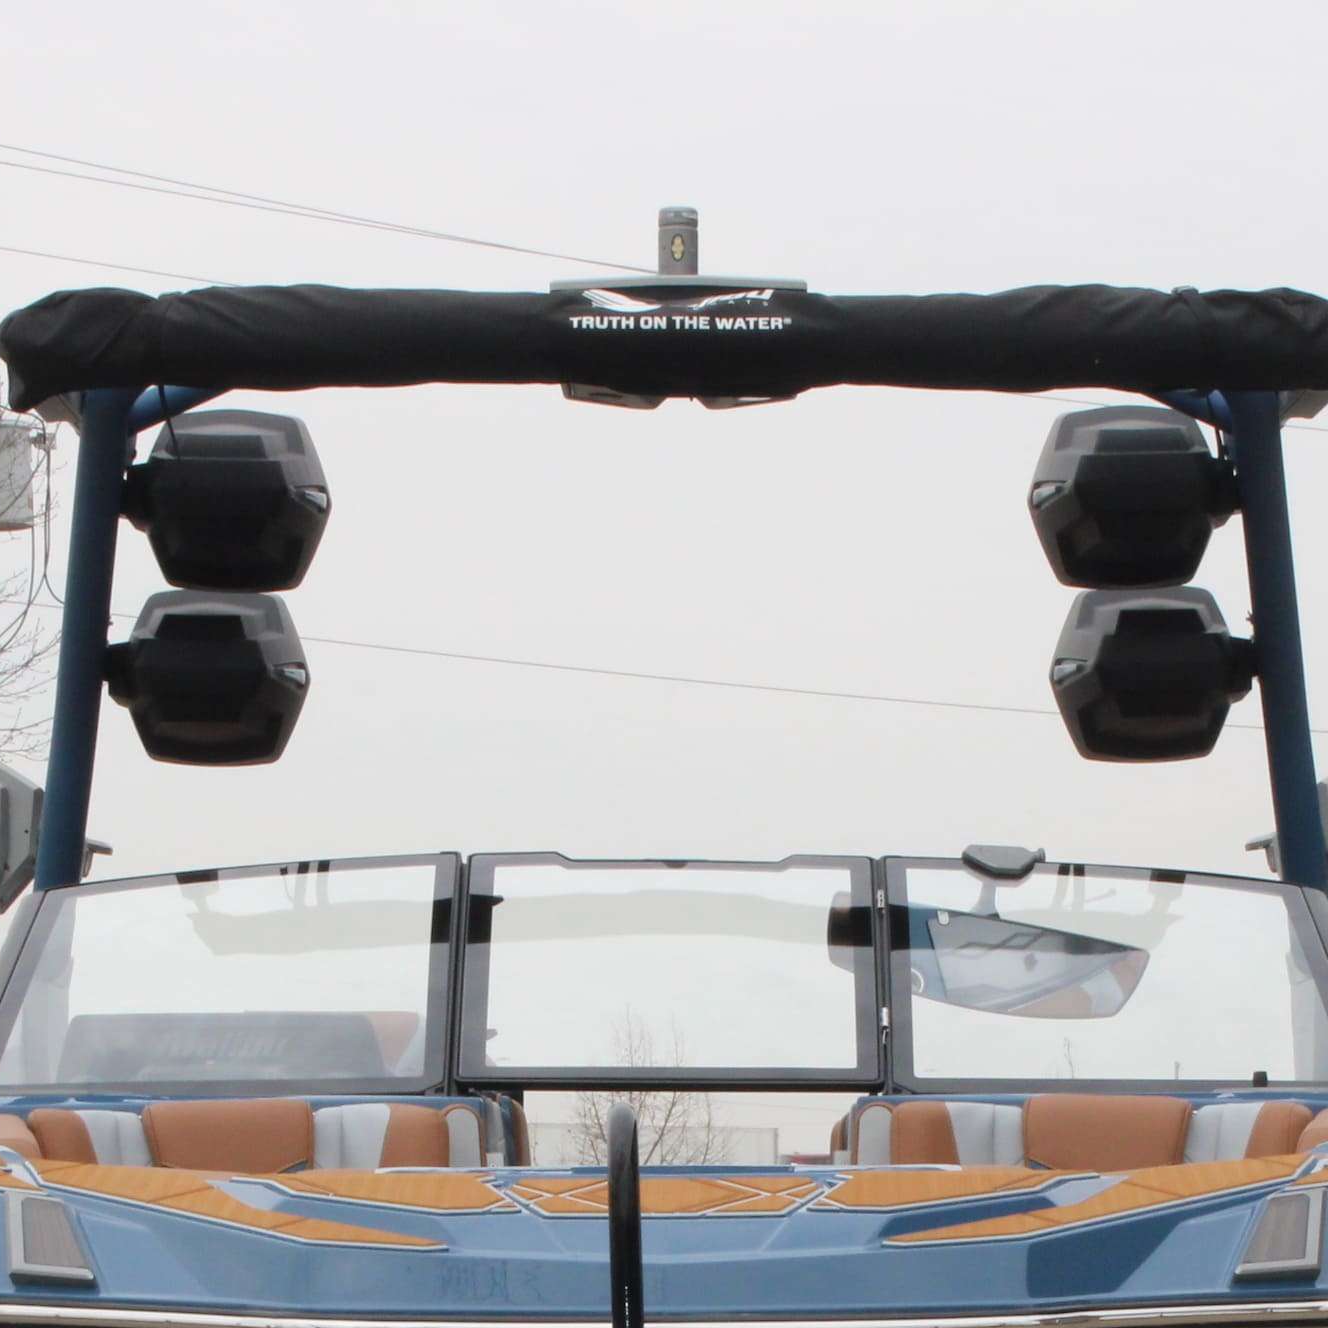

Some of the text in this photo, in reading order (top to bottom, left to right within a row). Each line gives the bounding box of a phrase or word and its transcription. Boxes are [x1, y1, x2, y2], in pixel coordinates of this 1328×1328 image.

[570, 316, 634, 330] TRUTH
[639, 316, 667, 330] ON
[672, 316, 710, 330] THE
